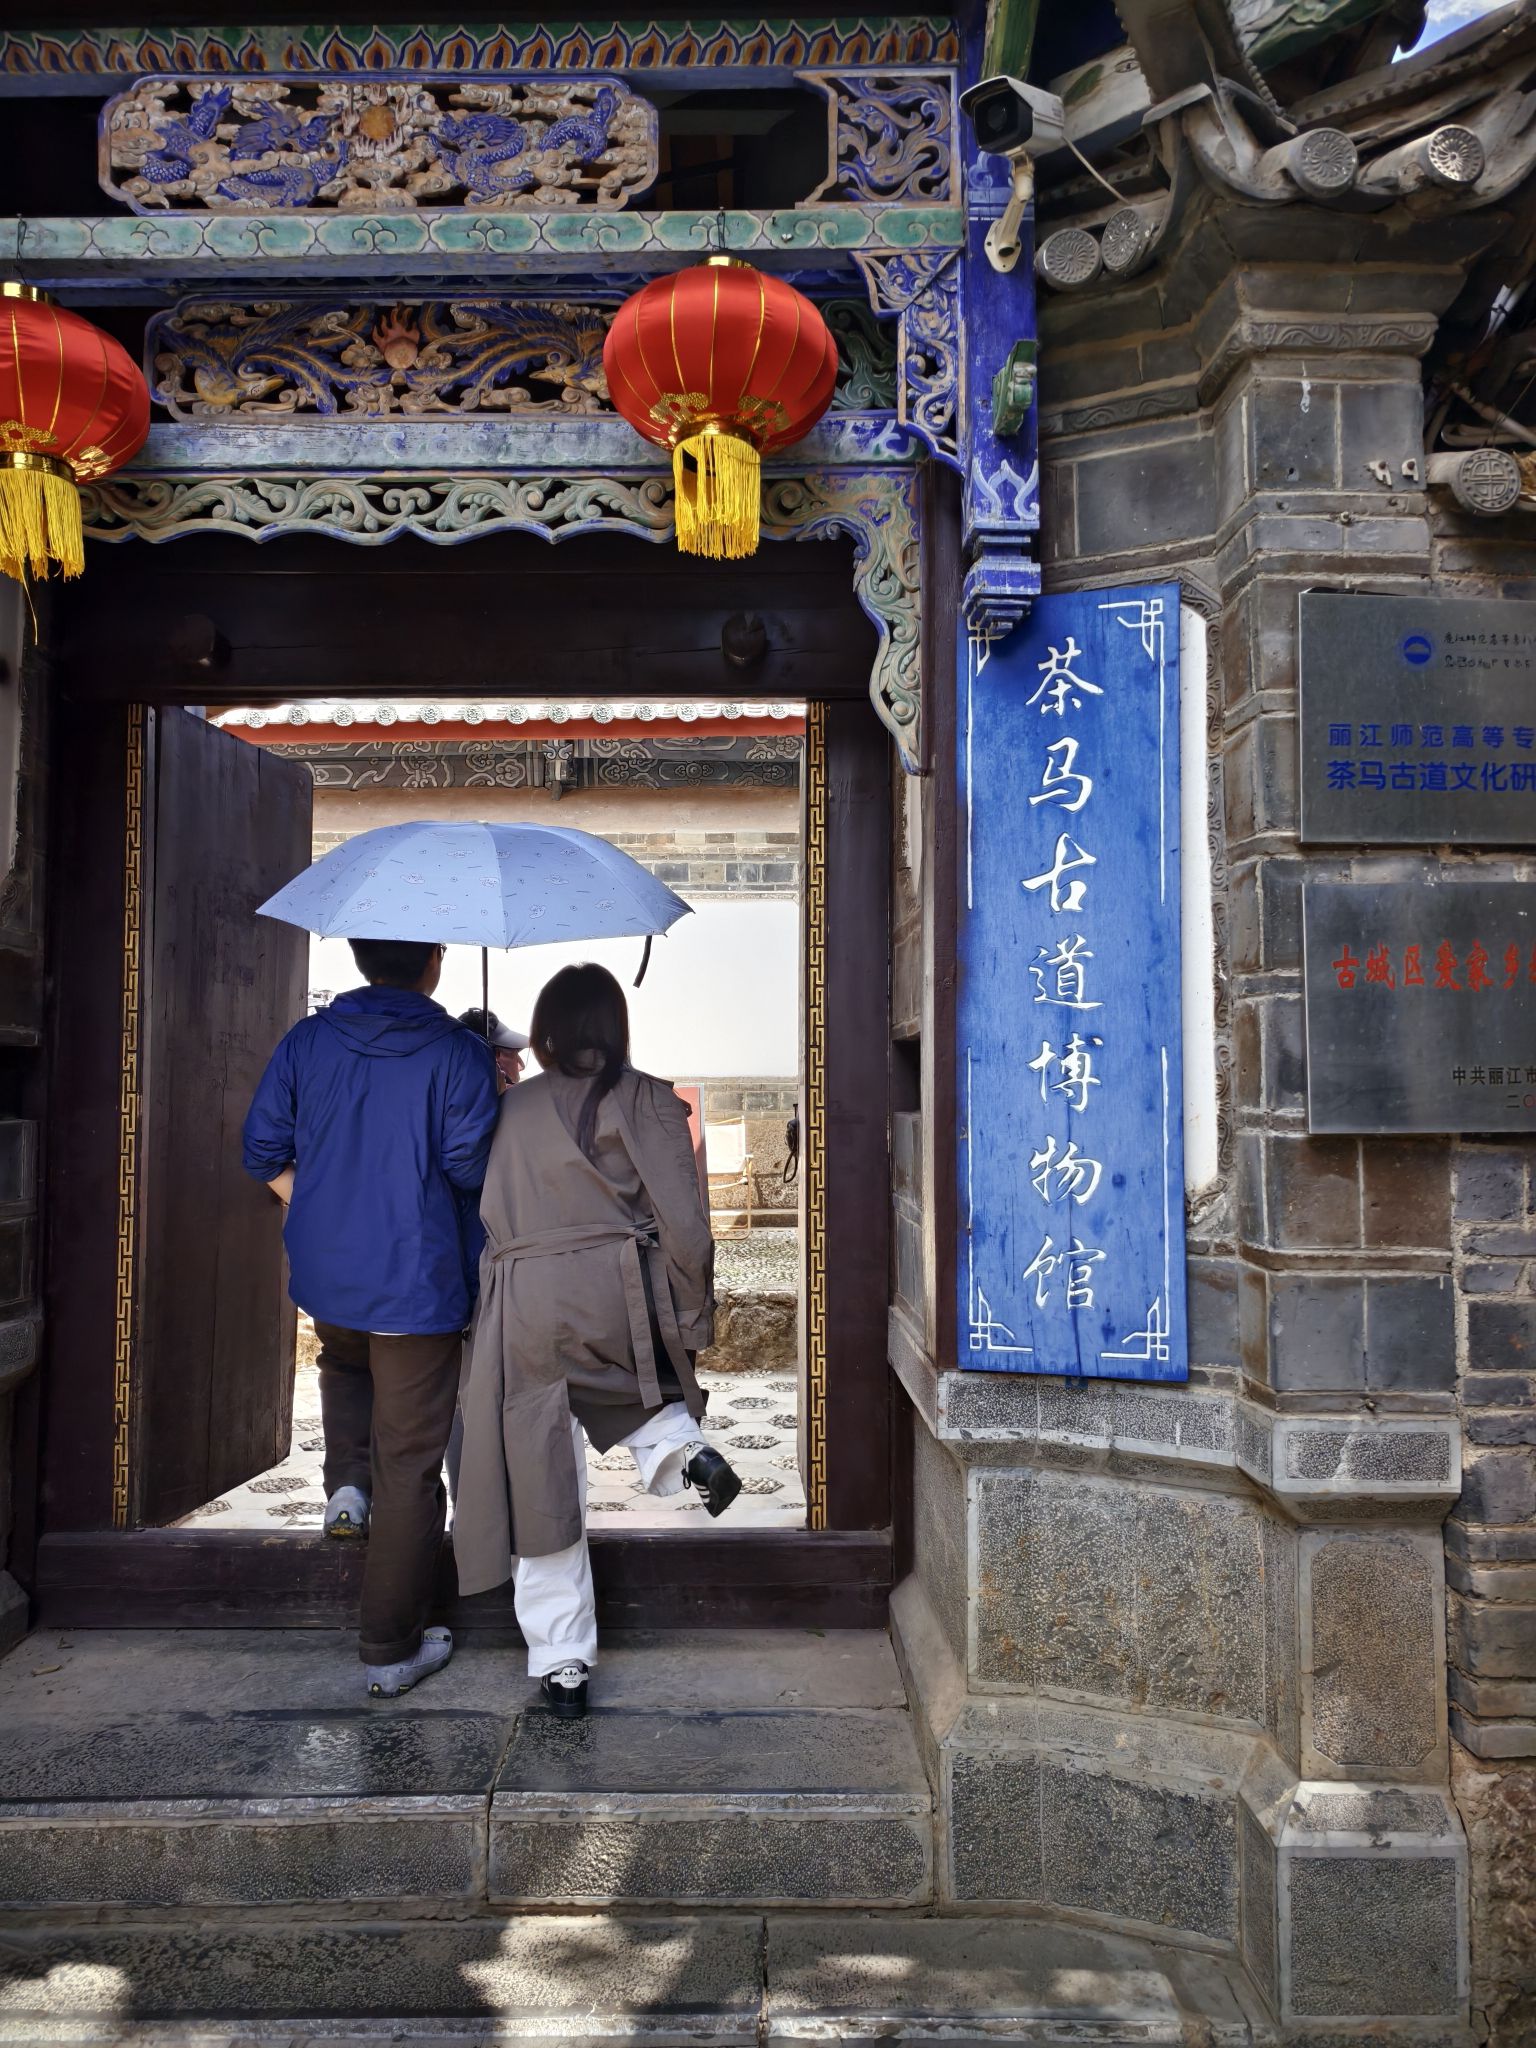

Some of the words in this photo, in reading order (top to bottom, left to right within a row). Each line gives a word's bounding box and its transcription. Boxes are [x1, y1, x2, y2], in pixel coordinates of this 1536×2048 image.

[1327, 722, 1536, 749] 丽江师范高等专
[1327, 759, 1536, 792] 茶马古道文化研
[1022, 635, 1107, 1312] 茶马古道博物馆
[1453, 1065, 1536, 1086] 中共丽江市
